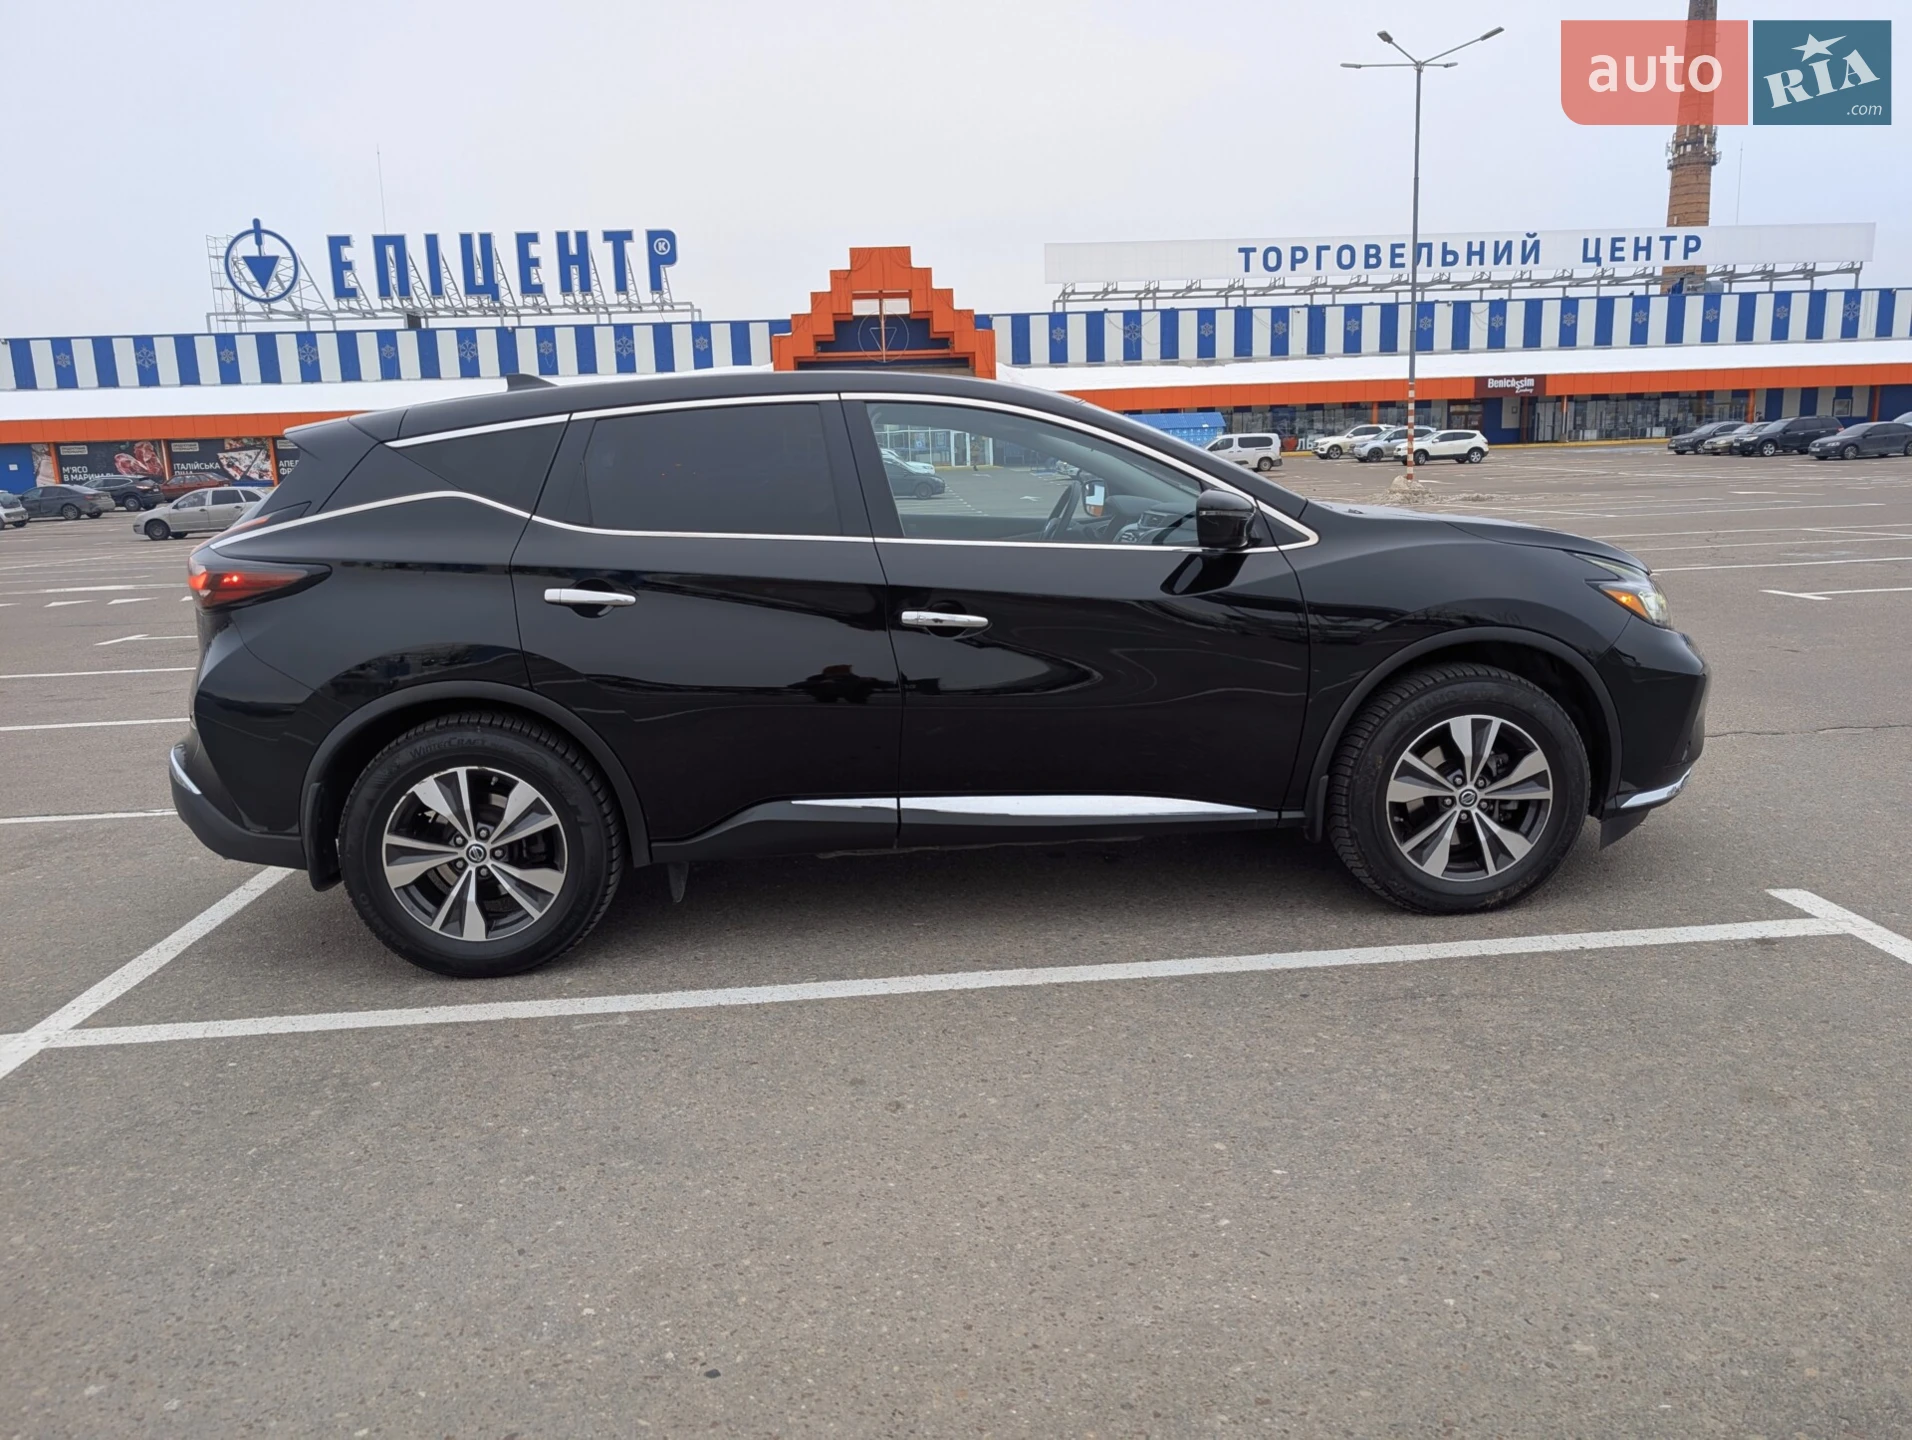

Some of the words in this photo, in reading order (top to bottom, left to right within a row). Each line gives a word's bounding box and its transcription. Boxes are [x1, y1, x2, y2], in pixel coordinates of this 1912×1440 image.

[1238, 232, 1541, 273] ТОРГОВЕЛЬНИЙ
[1581, 234, 1703, 267] ЦЕНТР
[327, 229, 678, 303] ЕПІЦЕНТР
[62, 466, 88, 474] М'ЯСО
[173, 461, 221, 471] ІТАЛІЙСЬКА
[63, 474, 70, 482] В
